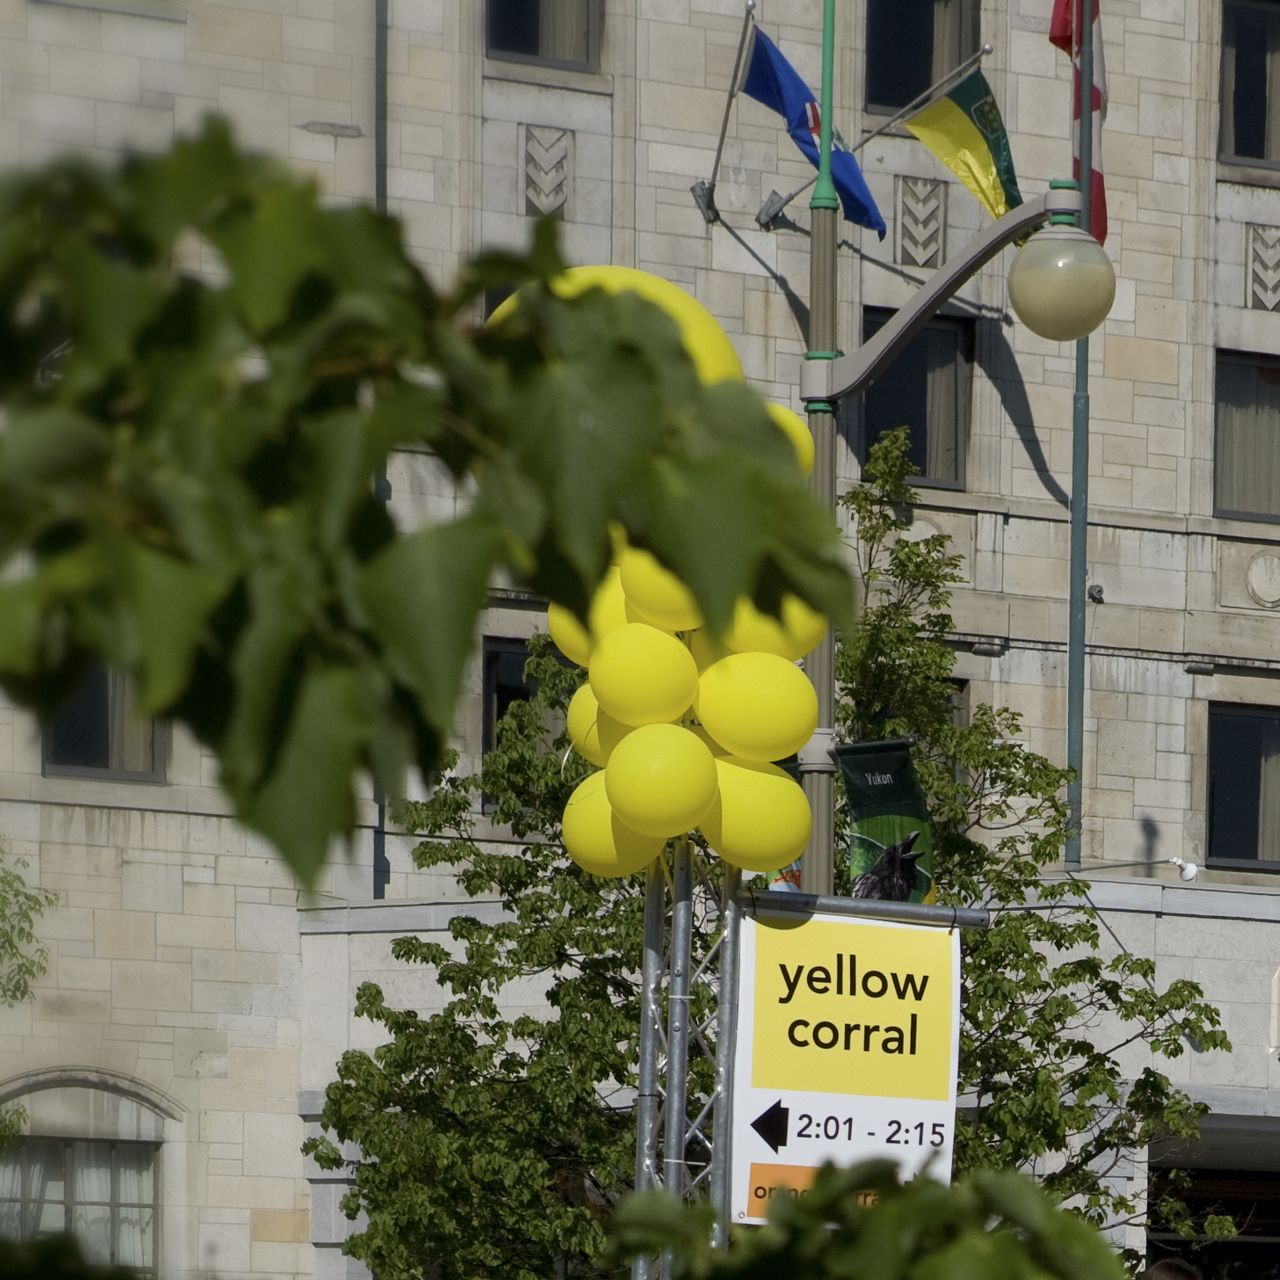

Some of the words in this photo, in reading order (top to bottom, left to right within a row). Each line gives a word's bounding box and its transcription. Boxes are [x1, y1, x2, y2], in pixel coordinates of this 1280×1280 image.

[864, 772, 894, 786] Yukon
[778, 953, 930, 1004] yellow
[787, 1013, 918, 1056] corral
[796, 1113, 854, 1141] 2:01
[885, 1119, 946, 1148] 2:15
